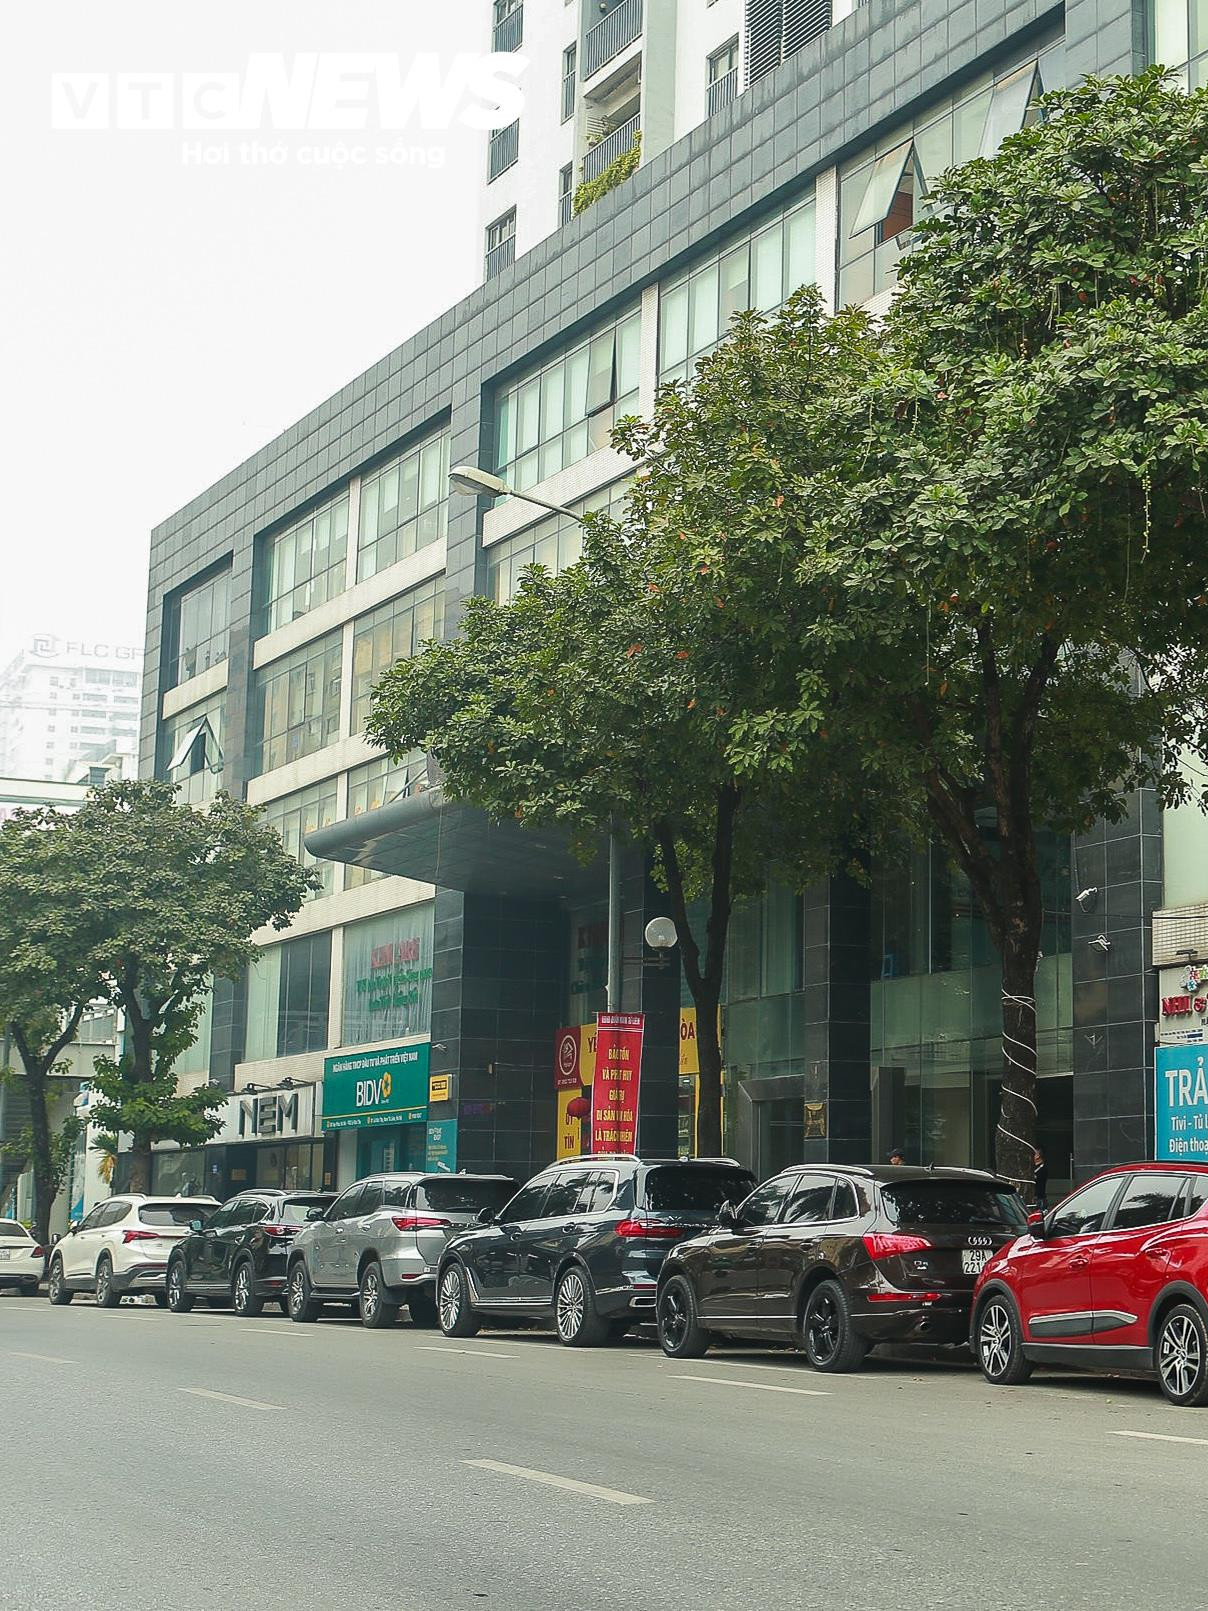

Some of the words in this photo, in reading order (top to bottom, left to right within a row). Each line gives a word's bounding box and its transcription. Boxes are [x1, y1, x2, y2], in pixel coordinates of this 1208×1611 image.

[66, 640, 109, 658] FLC
[1162, 995, 1191, 1016] NHI
[1165, 1056, 1208, 1107] TRẢ
[356, 1079, 382, 1107] BIDV
[239, 1094, 298, 1136] NEM
[1171, 1115, 1187, 1131] Tivi
[1193, 1114, 1204, 1129] Tủ
[564, 1133, 574, 1150] TÍN
[1169, 1135, 1188, 1155] Điện
[970, 1250, 987, 1261] 29A
